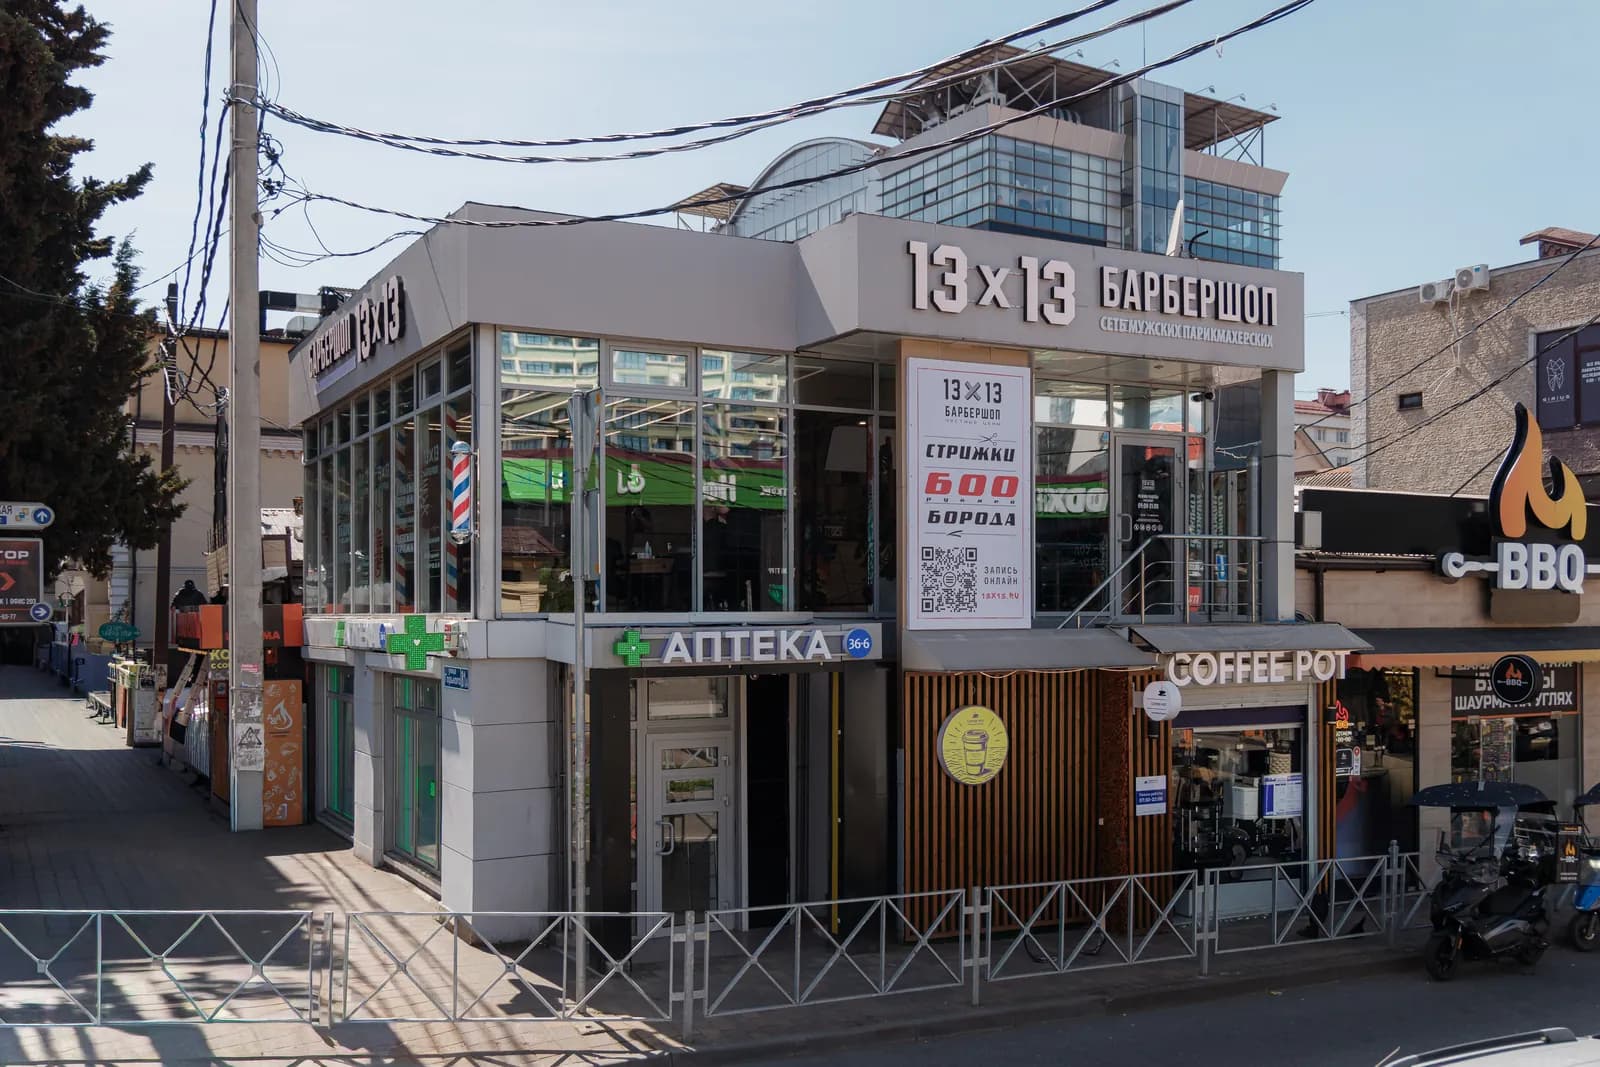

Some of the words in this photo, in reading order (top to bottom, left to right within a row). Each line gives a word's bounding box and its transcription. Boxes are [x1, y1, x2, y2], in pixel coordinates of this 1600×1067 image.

[1099, 265, 1279, 326] БАРБЕРШОП
[1099, 315, 1128, 333] СЕТЬ
[1128, 320, 1183, 338] МУЖСКИХ
[1183, 324, 1273, 348] ПАРИКМАХЕРСКИХ
[308, 312, 352, 378] БАРБЕРШОП
[945, 405, 1001, 421] БАРБЕРШОП
[925, 443, 1016, 463] СТРИЖКИ
[924, 472, 1020, 498] 600
[927, 510, 1017, 527] БОРОДА
[984, 566, 1018, 575] ЗАПИСЬ
[984, 575, 1018, 585] ОНЛАЙН
[1498, 542, 1585, 594] BBQ
[662, 629, 833, 664] АПТЕКА
[1168, 651, 1285, 687] COFFEE
[1296, 650, 1351, 682] POT
[1505, 678, 1523, 687] BBQ
